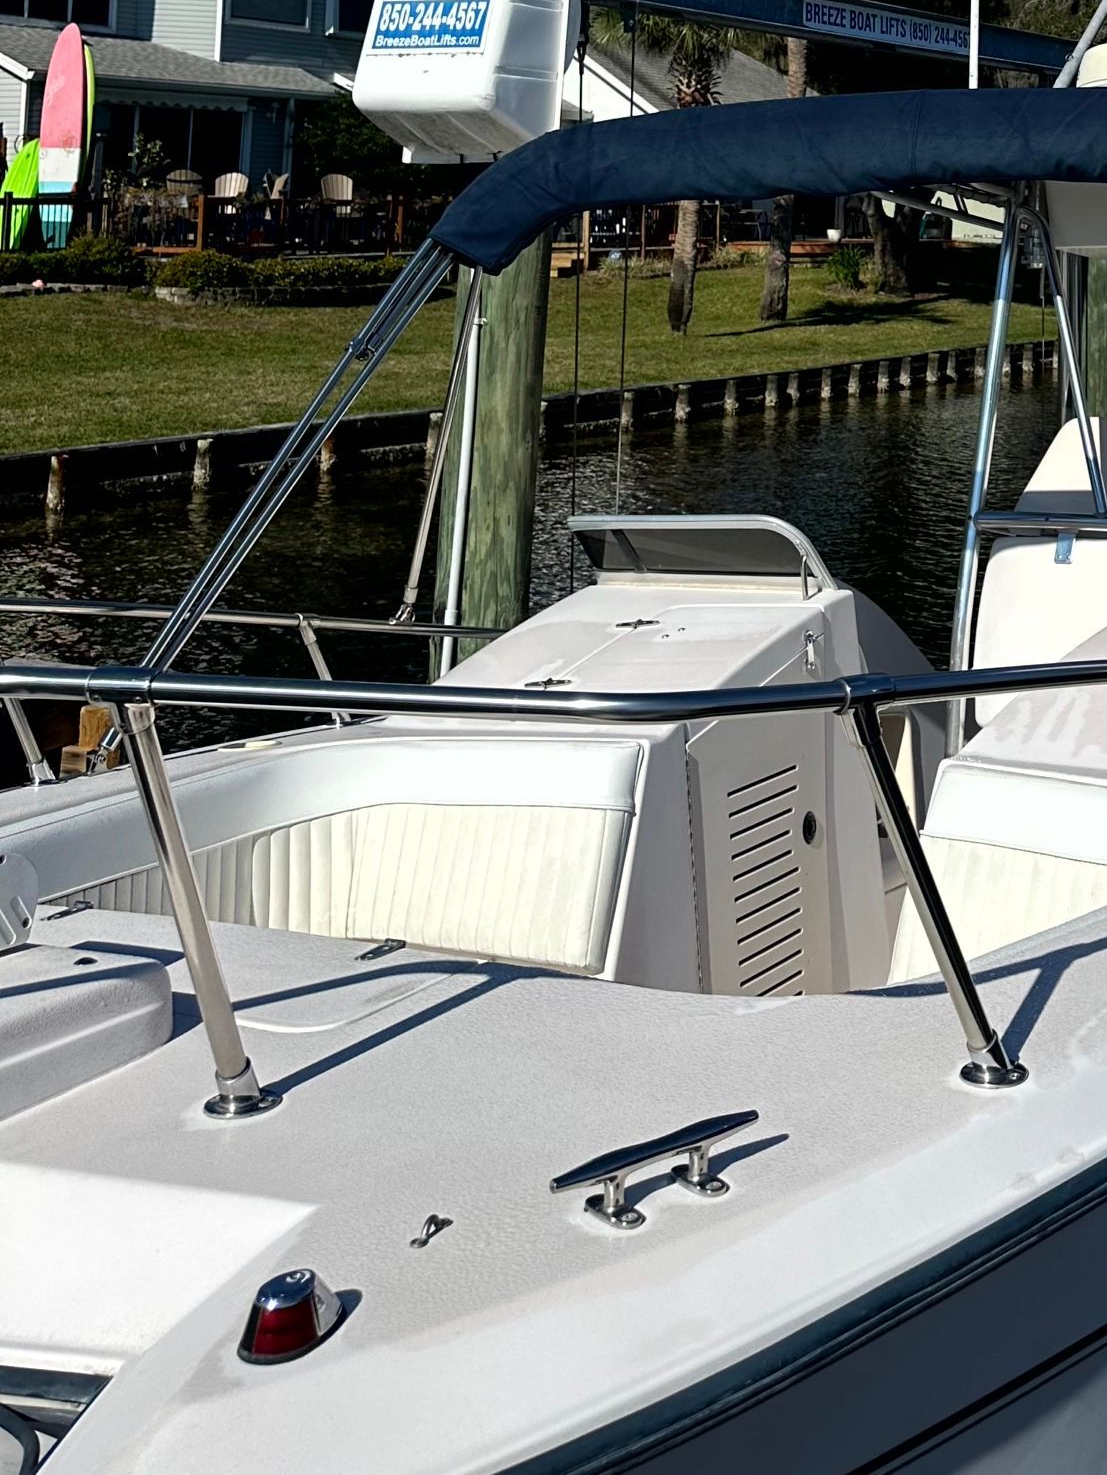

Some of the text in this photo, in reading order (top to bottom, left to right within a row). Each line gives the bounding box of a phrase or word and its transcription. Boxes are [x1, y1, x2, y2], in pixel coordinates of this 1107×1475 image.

[379, 1, 487, 32] 850-244-4567
[805, 2, 970, 48] BREEZE BOAT LIFTS (850) 244-456
[375, 33, 480, 47] BreezeBoatLifts.com
